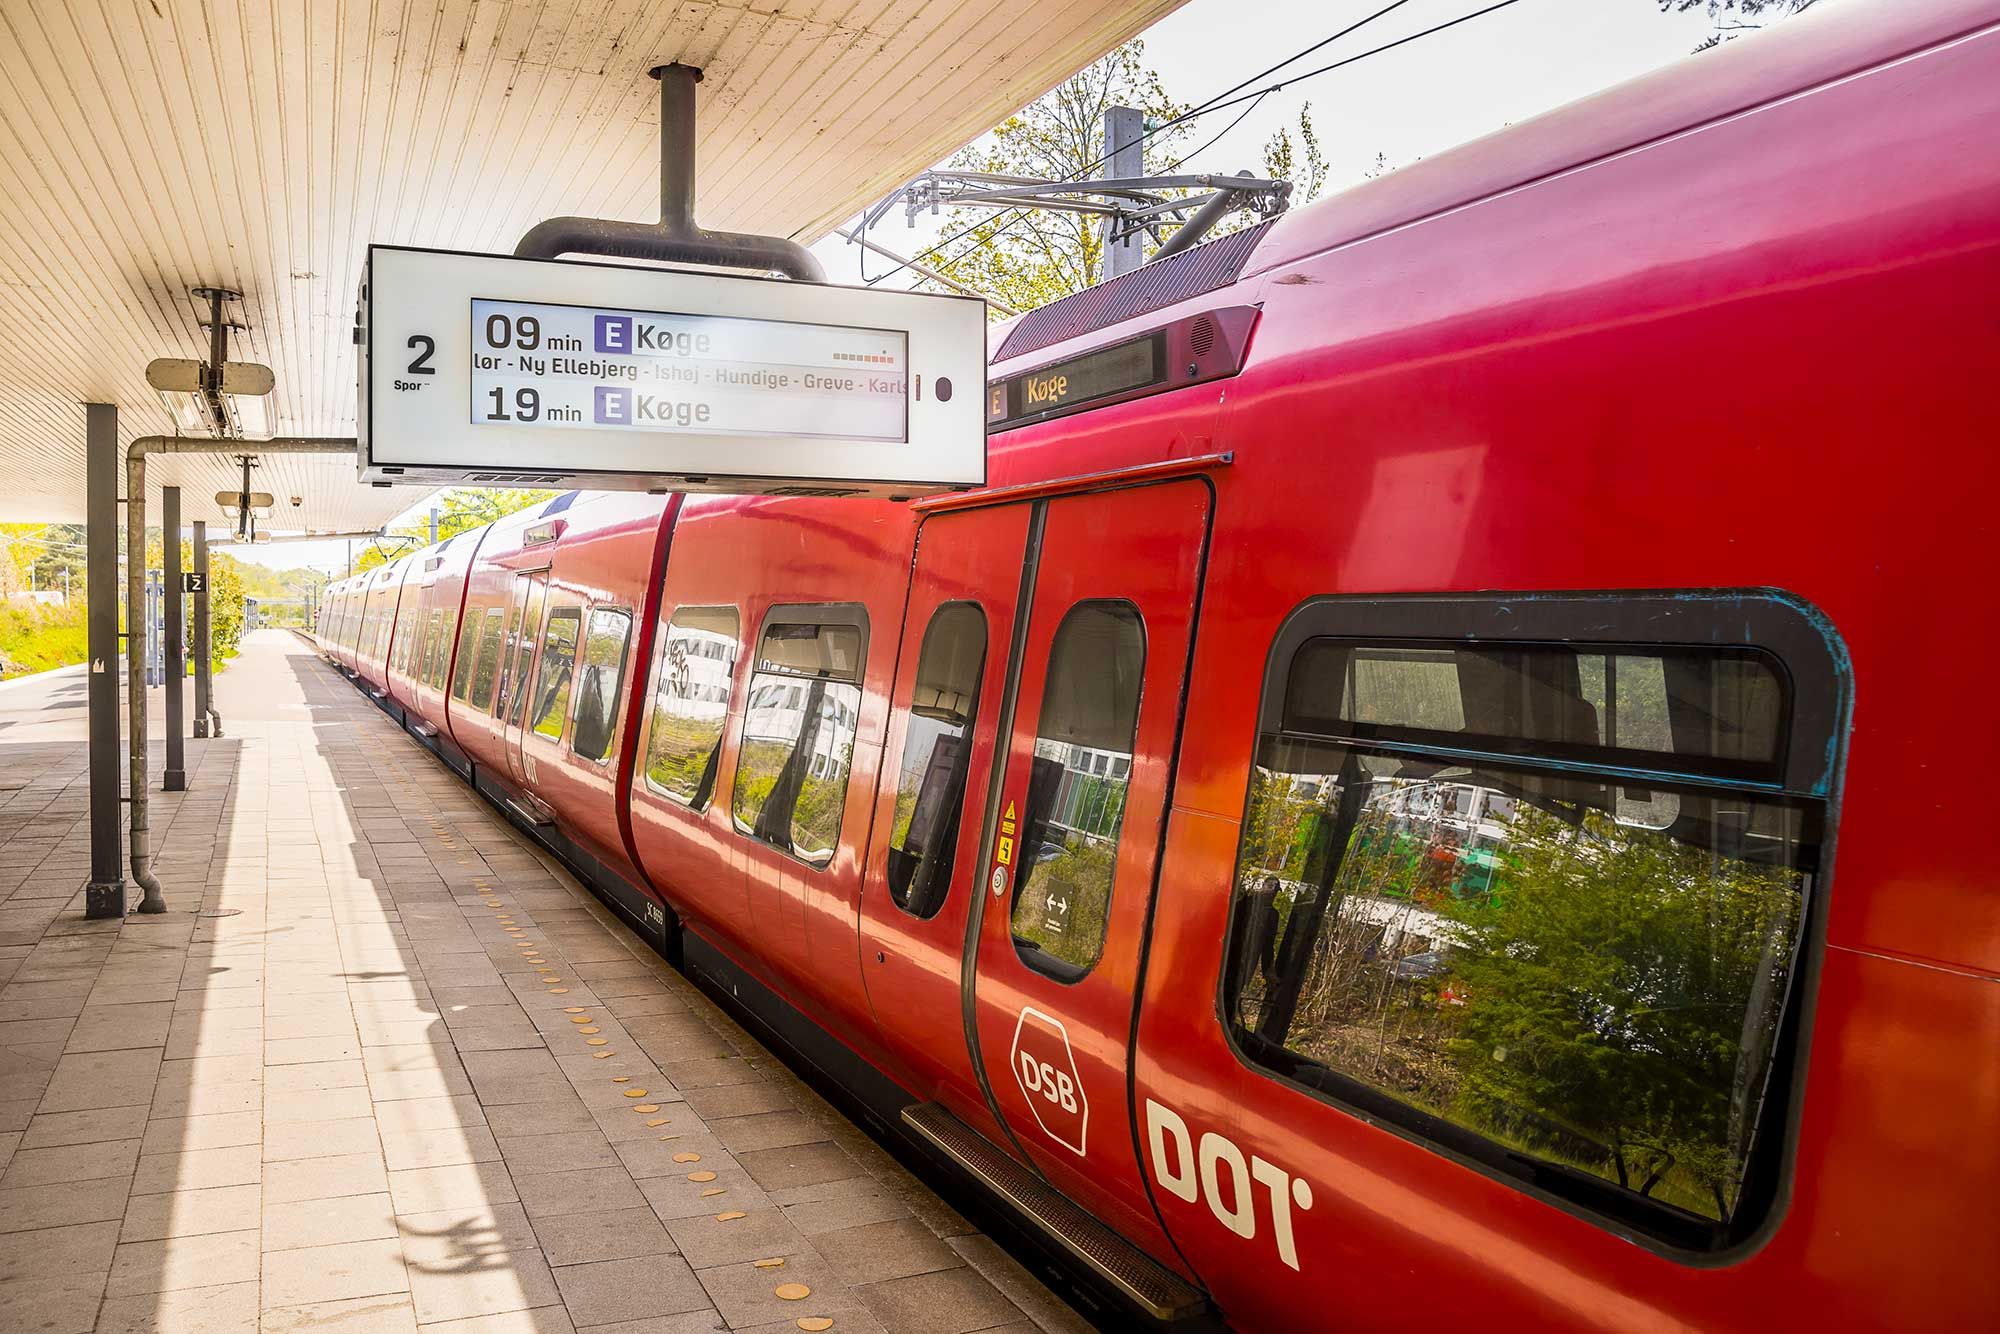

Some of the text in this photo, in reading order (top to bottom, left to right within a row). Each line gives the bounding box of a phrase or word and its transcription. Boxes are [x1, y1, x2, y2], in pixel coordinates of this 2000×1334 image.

[407, 334, 436, 375] 2
[486, 314, 711, 356] 09 min E Køge
[394, 380, 422, 392] Spor
[474, 353, 502, 370] lør
[519, 356, 545, 376] Ny
[552, 358, 638, 381] Ellebjerg
[655, 364, 699, 384] Ishøj
[716, 368, 789, 390] Hundige
[804, 373, 854, 391] Greve
[487, 386, 711, 427] 19 min E Køge
[992, 374, 1067, 415] E Køge
[1020, 1049, 1078, 1114] DSB
[1146, 1098, 1313, 1272] DOT
